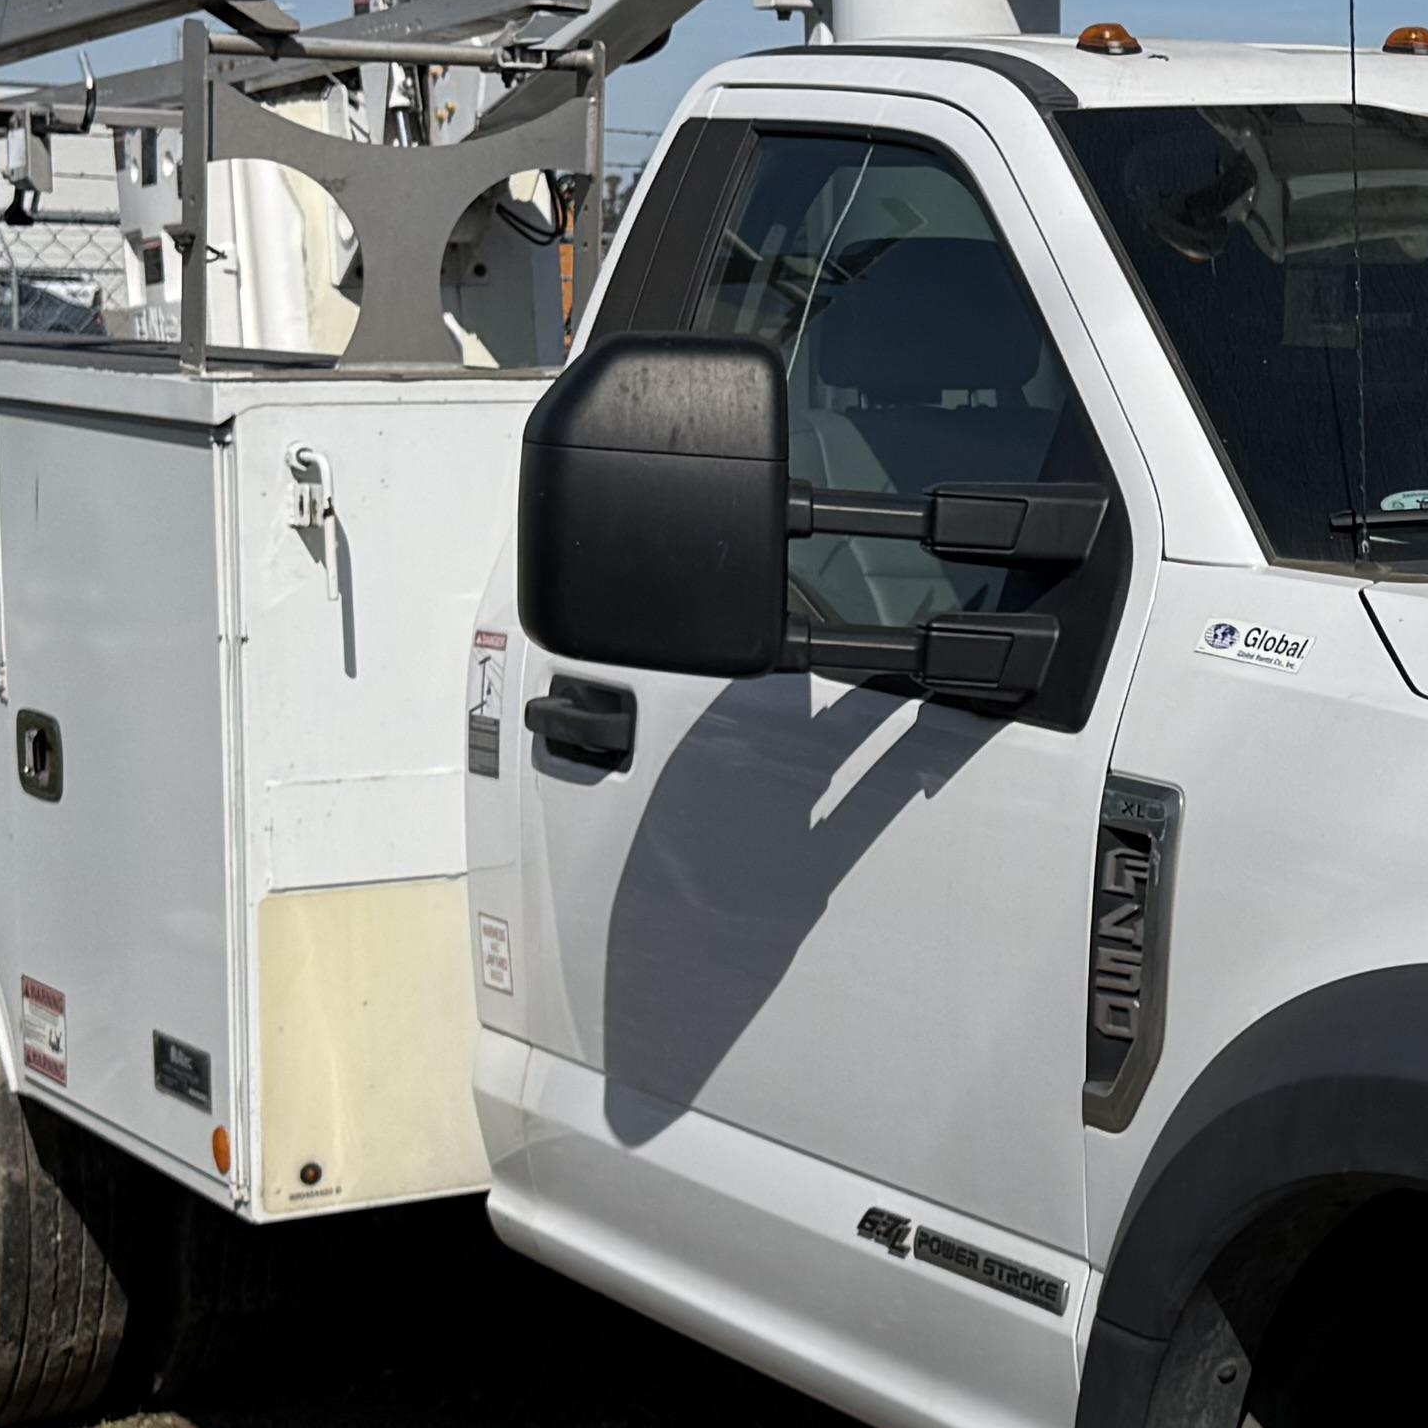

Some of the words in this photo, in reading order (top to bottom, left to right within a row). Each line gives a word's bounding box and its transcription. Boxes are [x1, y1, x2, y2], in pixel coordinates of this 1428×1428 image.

[1122, 800, 1146, 819] XL
[856, 1206, 912, 1259] 6.7L
[917, 1230, 980, 1271] POWER
[982, 1257, 1060, 1303] STROKE
